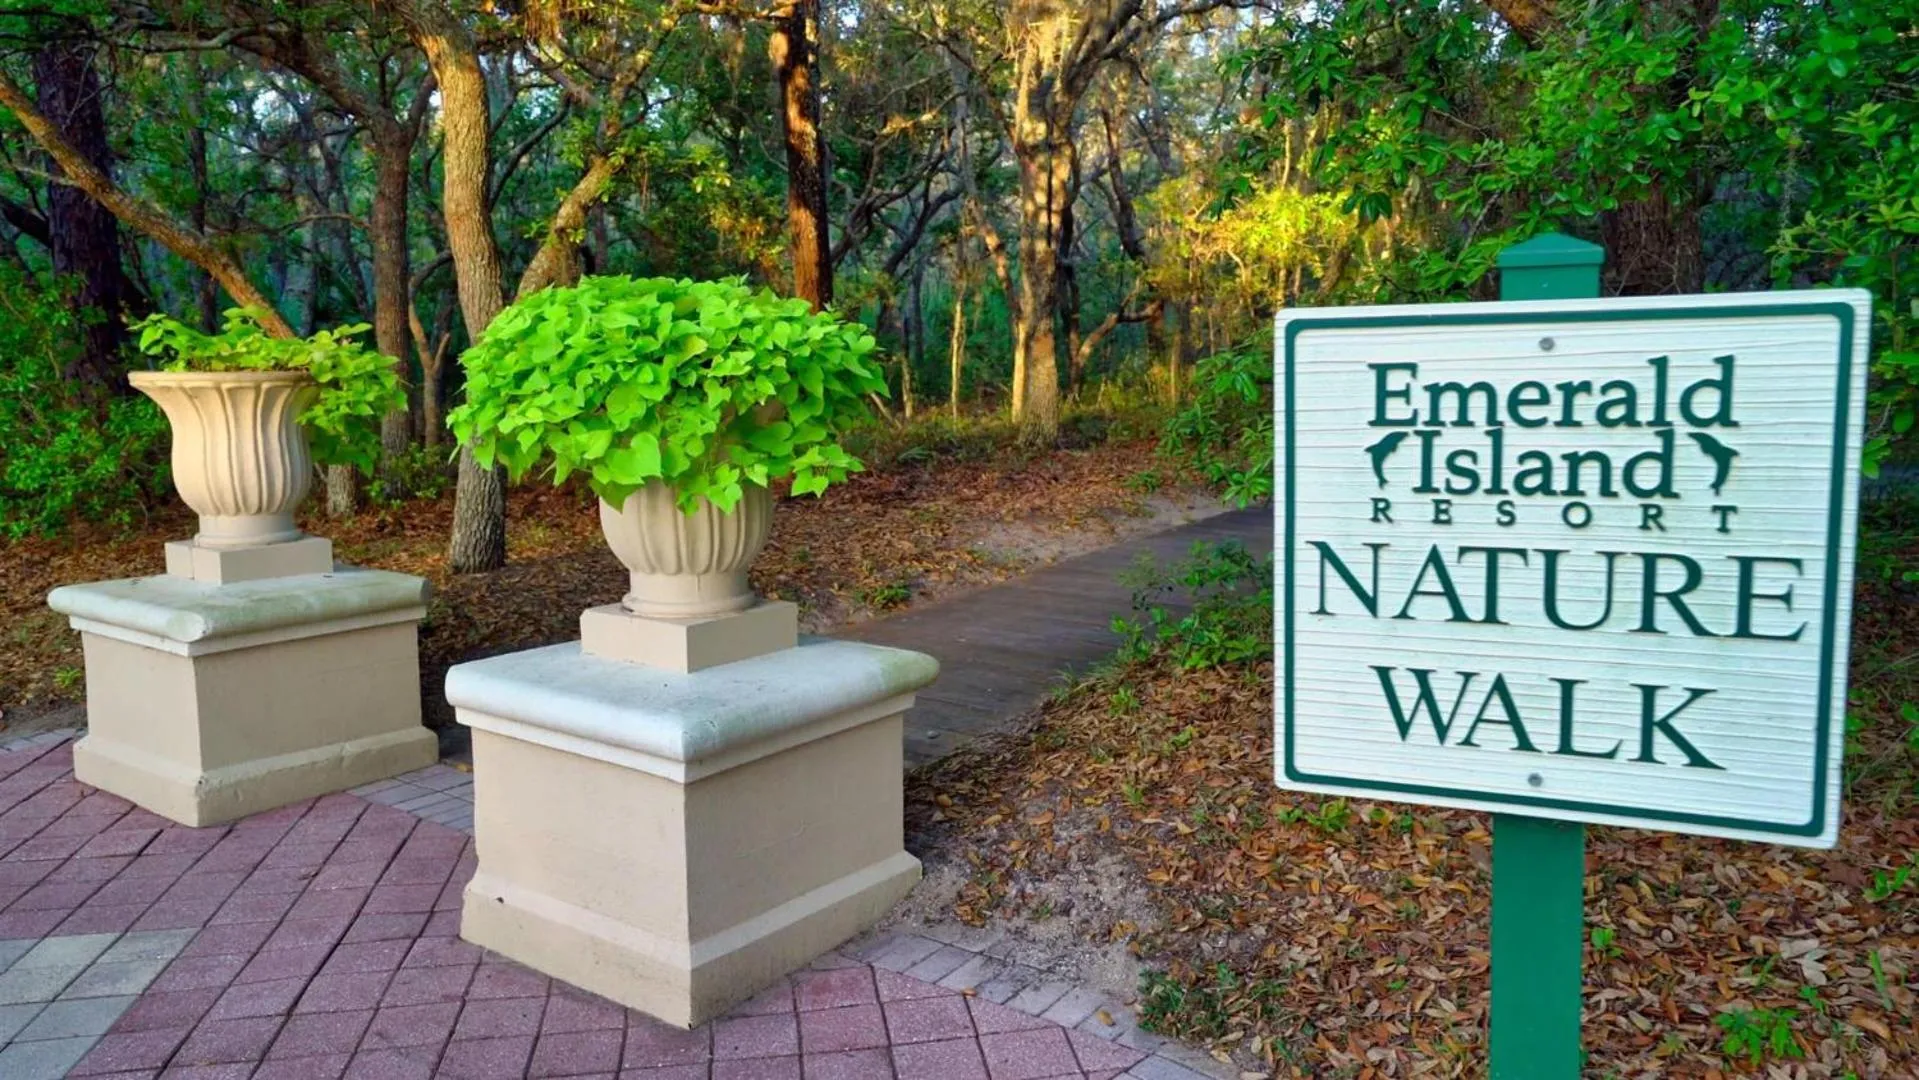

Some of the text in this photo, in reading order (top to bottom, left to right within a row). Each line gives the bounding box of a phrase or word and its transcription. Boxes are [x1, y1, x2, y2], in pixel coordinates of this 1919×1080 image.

[1367, 354, 1740, 428] Emerald
[1412, 427, 1682, 499] Island
[1369, 497, 1739, 534] RESORT
[1305, 540, 1807, 643] NATURE
[1369, 665, 1727, 771] WALK
